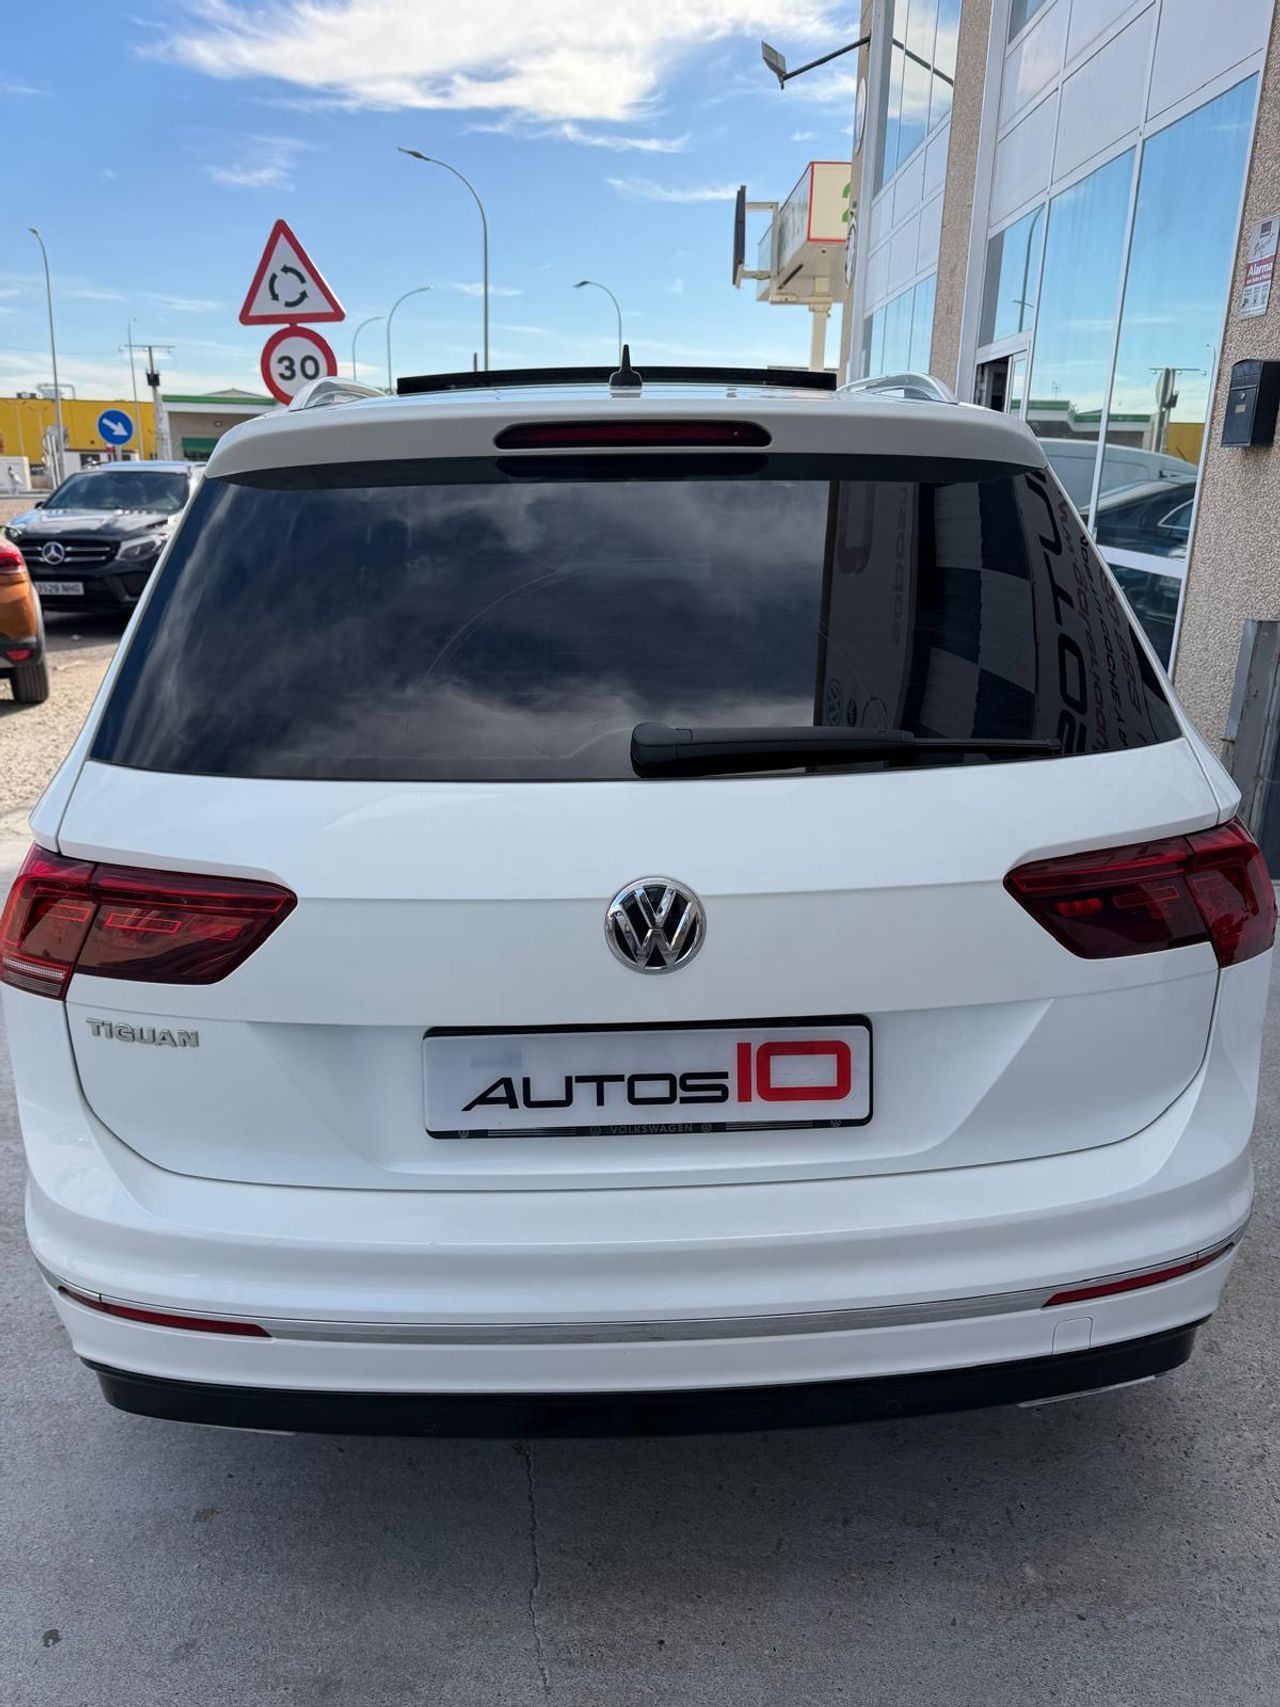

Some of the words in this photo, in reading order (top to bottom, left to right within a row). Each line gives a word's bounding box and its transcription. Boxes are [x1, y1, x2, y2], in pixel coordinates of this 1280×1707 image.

[277, 354, 320, 381] 30
[85, 1017, 200, 1048] TIGUAN
[610, 1123, 693, 1135] VOLKSWAGEN
